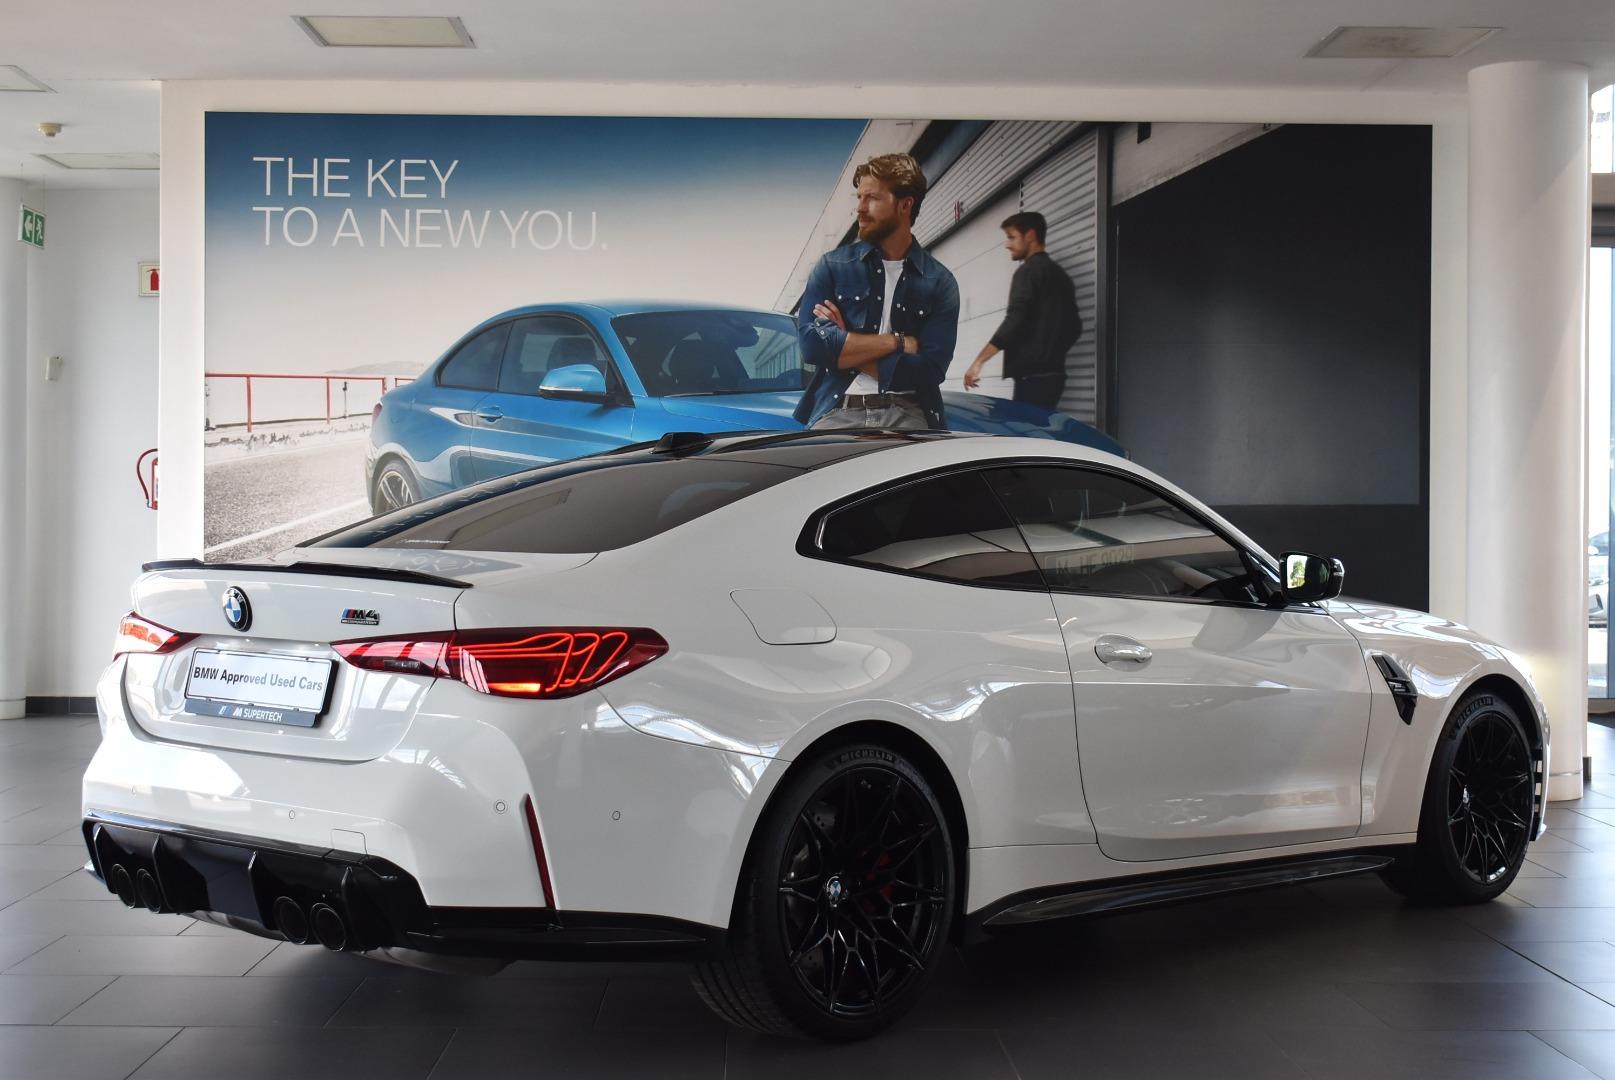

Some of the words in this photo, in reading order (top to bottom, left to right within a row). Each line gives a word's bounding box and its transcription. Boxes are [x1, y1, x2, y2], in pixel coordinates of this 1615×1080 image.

[253, 156, 350, 197] THE
[367, 158, 459, 199] KEY
[252, 206, 318, 247] TO
[331, 207, 365, 248] A
[379, 207, 491, 249] NEW
[499, 209, 608, 250] YOU.
[193, 666, 219, 680] BMW
[220, 669, 267, 685] Approved
[269, 674, 296, 688] Used
[298, 676, 323, 691] Cars
[243, 708, 283, 722] SUPERTECH
